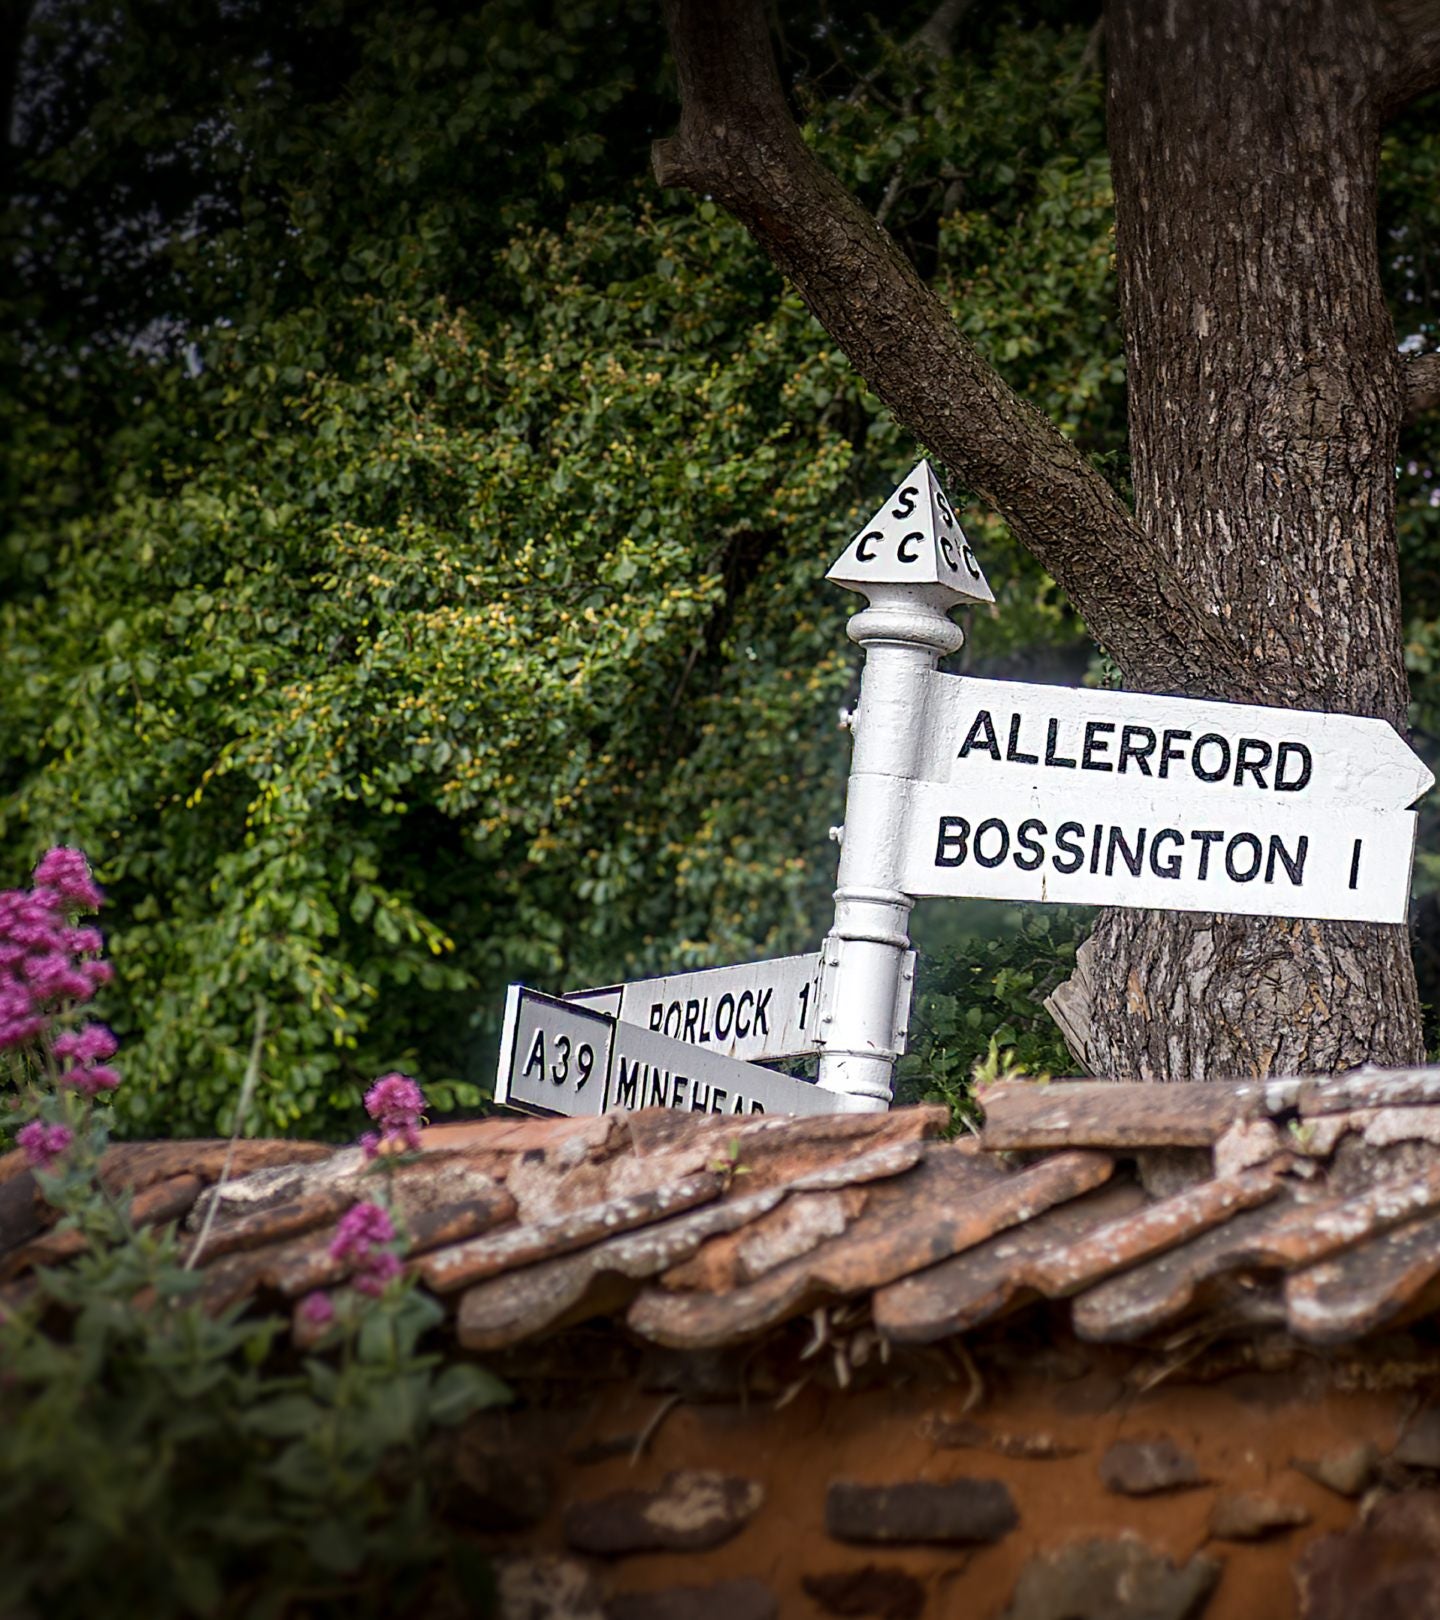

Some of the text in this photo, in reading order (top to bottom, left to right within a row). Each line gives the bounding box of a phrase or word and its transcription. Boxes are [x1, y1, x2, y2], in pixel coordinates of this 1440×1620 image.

[957, 709, 1313, 793] ALLERFORD
[934, 815, 1309, 887] BOSSINGTON
[650, 987, 773, 1044] PORLOCK
[522, 1029, 595, 1093] A39
